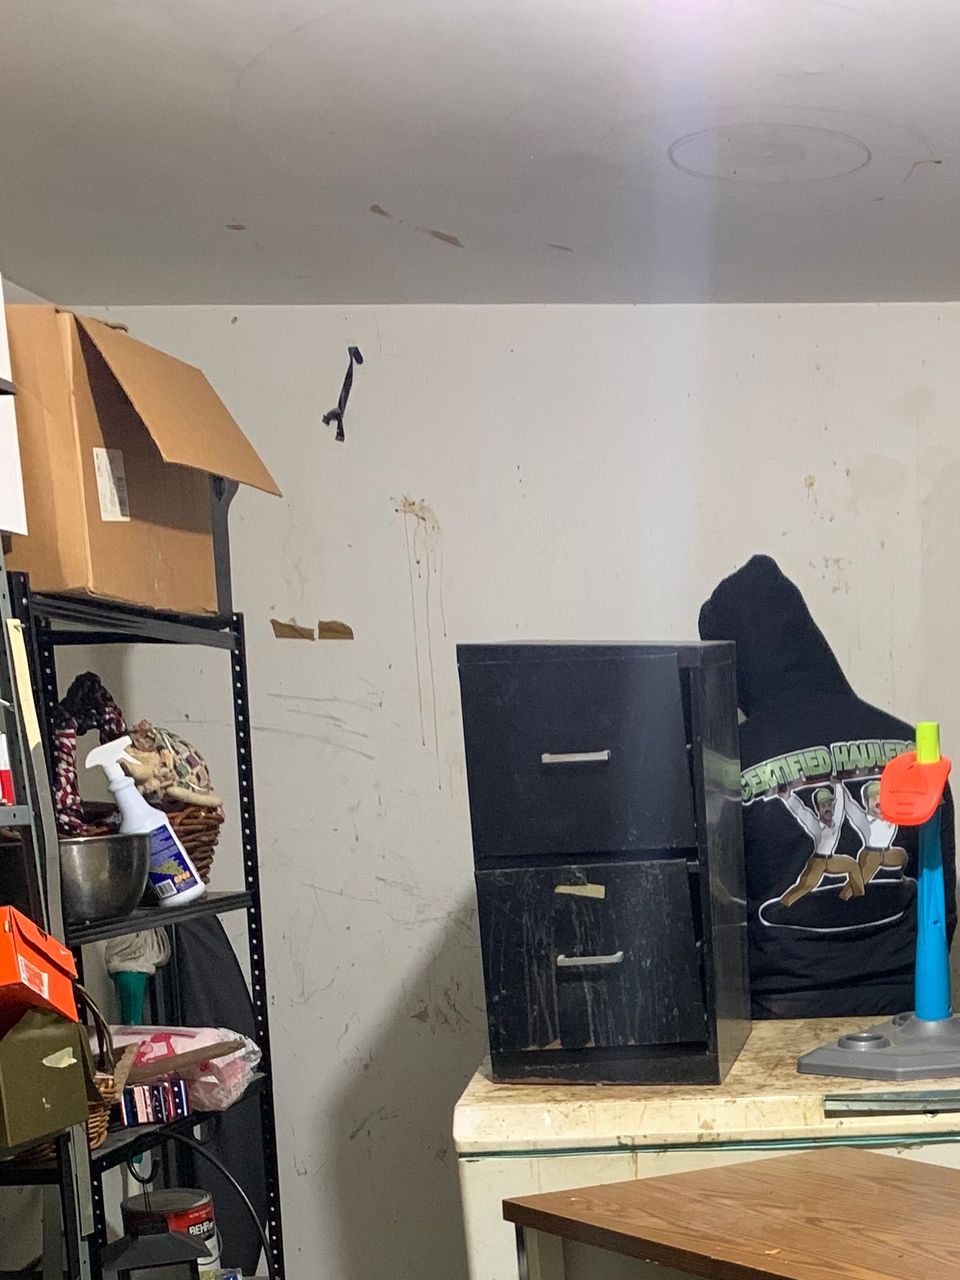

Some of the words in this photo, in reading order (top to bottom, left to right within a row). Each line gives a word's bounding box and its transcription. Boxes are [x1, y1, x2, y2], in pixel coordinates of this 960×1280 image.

[741, 748, 831, 800] CERTIFIED
[832, 740, 916, 772] HAULE
[189, 1220, 211, 1236] BEHR
